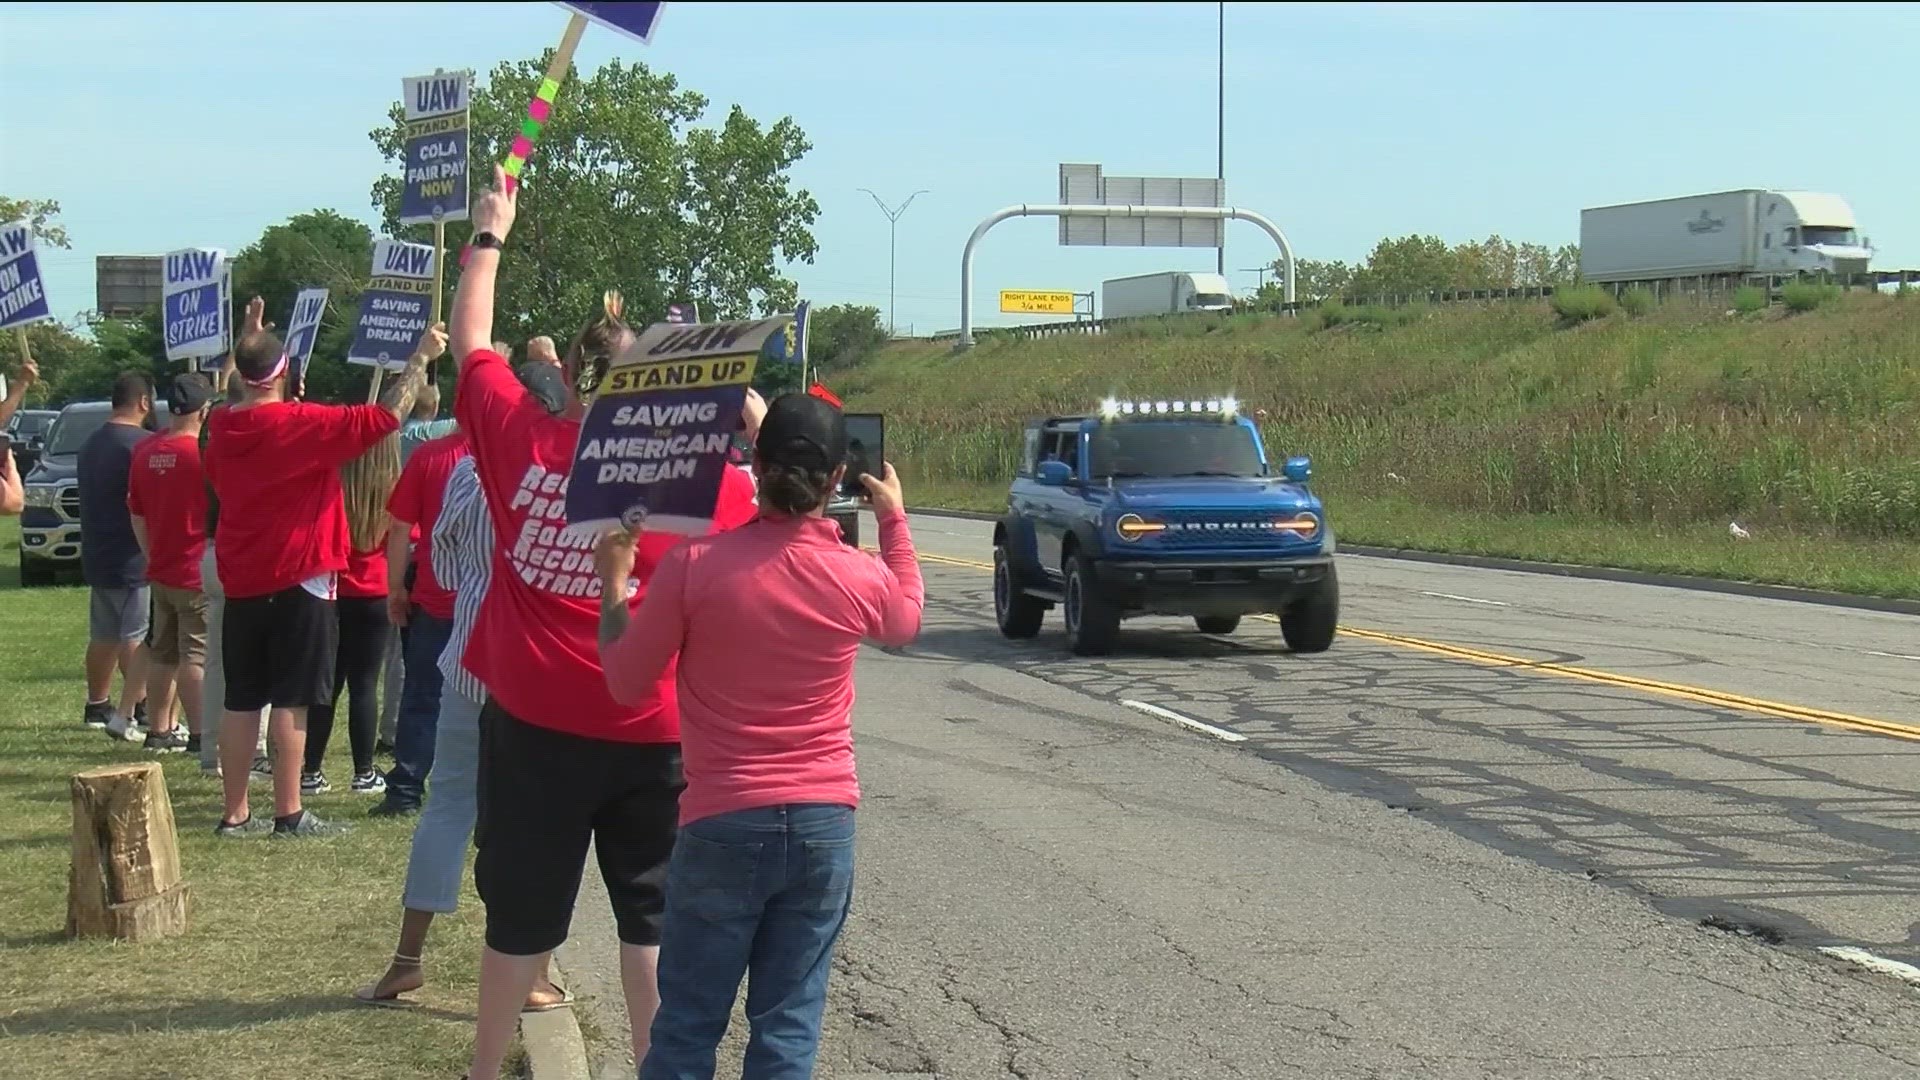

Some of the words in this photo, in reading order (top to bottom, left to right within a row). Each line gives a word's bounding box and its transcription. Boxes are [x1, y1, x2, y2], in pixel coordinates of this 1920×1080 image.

[416, 79, 460, 112] UAW
[407, 120, 449, 137] STAND
[420, 141, 457, 161] COLA
[408, 165, 439, 184] FAIR
[440, 159, 466, 179] PAY
[421, 179, 455, 198] NOW
[168, 251, 217, 283] UAW
[385, 245, 432, 275] UAW
[0, 277, 42, 320] TRIKE
[367, 278, 412, 291] STAND
[416, 282, 432, 293] UP
[180, 289, 201, 316] ON
[371, 298, 421, 313] SAVING
[169, 311, 218, 345] STRIKE
[360, 315, 426, 330] AMERICAN
[366, 328, 413, 343] DREAM
[648, 322, 768, 355] UAW
[611, 364, 703, 390] STAND
[712, 361, 747, 382] UP
[612, 402, 719, 426] SAVING
[580, 433, 730, 461] AMERICAN
[520, 464, 570, 494] RE
[597, 459, 697, 485] DREAM
[511, 488, 568, 520] PRO
[521, 519, 601, 551] EQUA
[513, 538, 595, 574] RECOR
